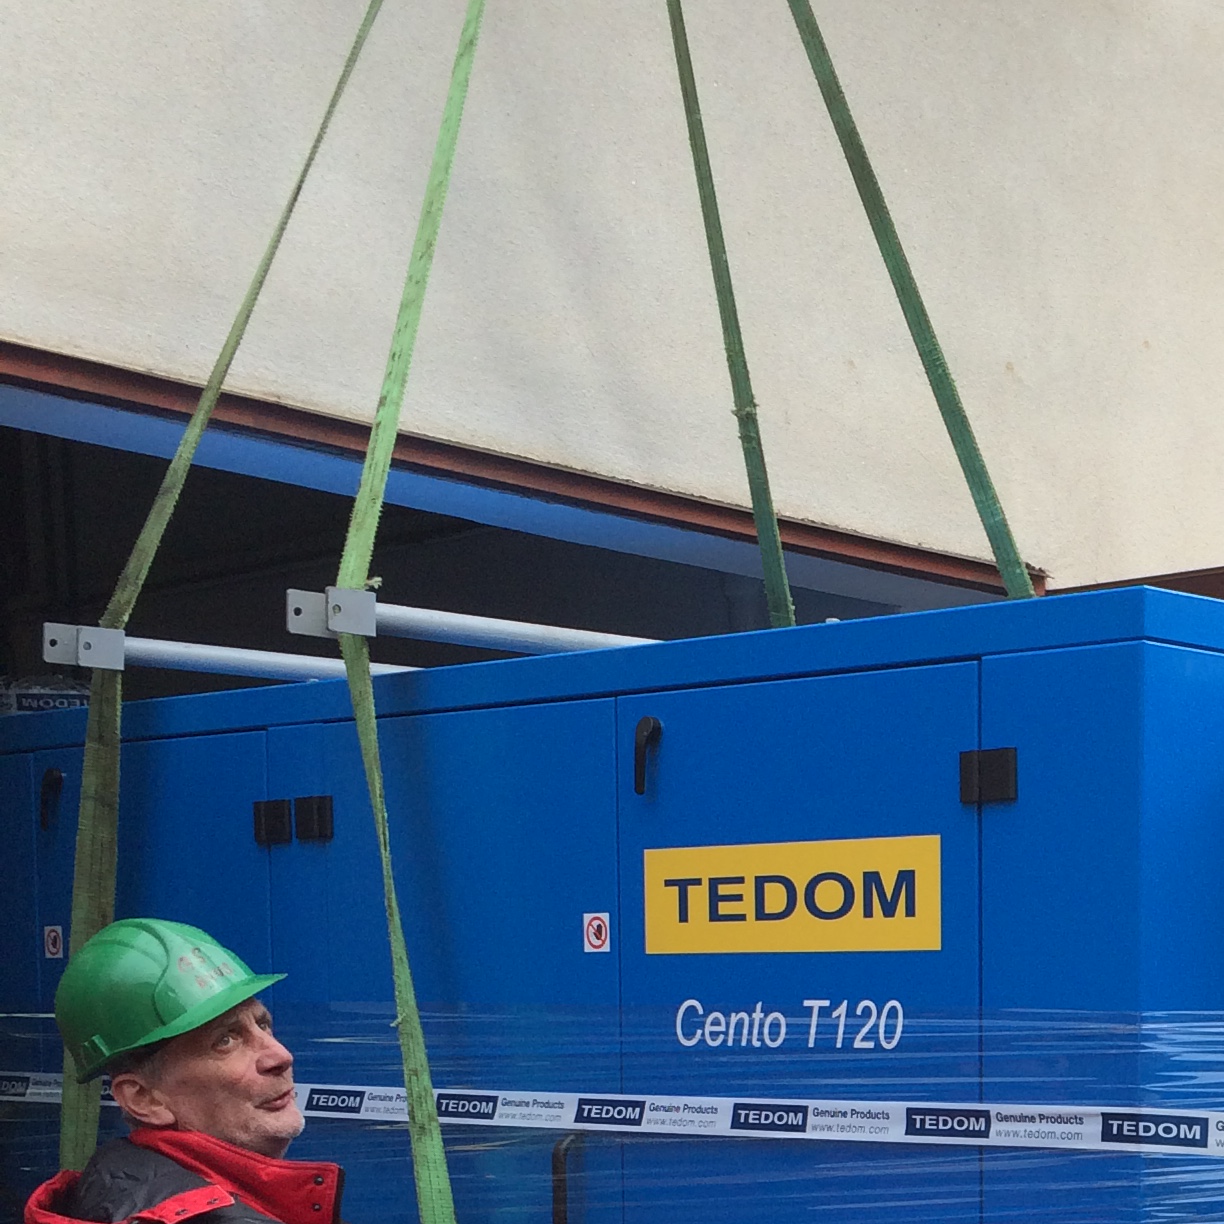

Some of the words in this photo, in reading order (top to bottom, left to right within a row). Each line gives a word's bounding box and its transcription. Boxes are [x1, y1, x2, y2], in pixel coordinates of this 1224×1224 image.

[664, 869, 916, 923] TEDOM
[676, 999, 787, 1048] Cento
[803, 999, 904, 1050] T120
[311, 1094, 361, 1108] TEDOM
[440, 1099, 494, 1114] TEDOM
[501, 1098, 530, 1107] Genuine
[532, 1099, 565, 1109] Products
[581, 1104, 641, 1120] TEDOM
[649, 1103, 681, 1113] Genuine
[683, 1104, 719, 1115] Products
[812, 1107, 848, 1119] Genuine
[850, 1108, 890, 1121] Products
[646, 1117, 717, 1129] www.tedom.com
[737, 1109, 804, 1126] TEDOM
[912, 1114, 986, 1131] TEDOM
[995, 1111, 1036, 1124] Genuine
[1038, 1113, 1084, 1126] Products
[811, 1123, 889, 1135] www.tedom.com
[995, 1128, 1083, 1141] www.tedom.com
[1108, 1120, 1201, 1140] TEDOM
